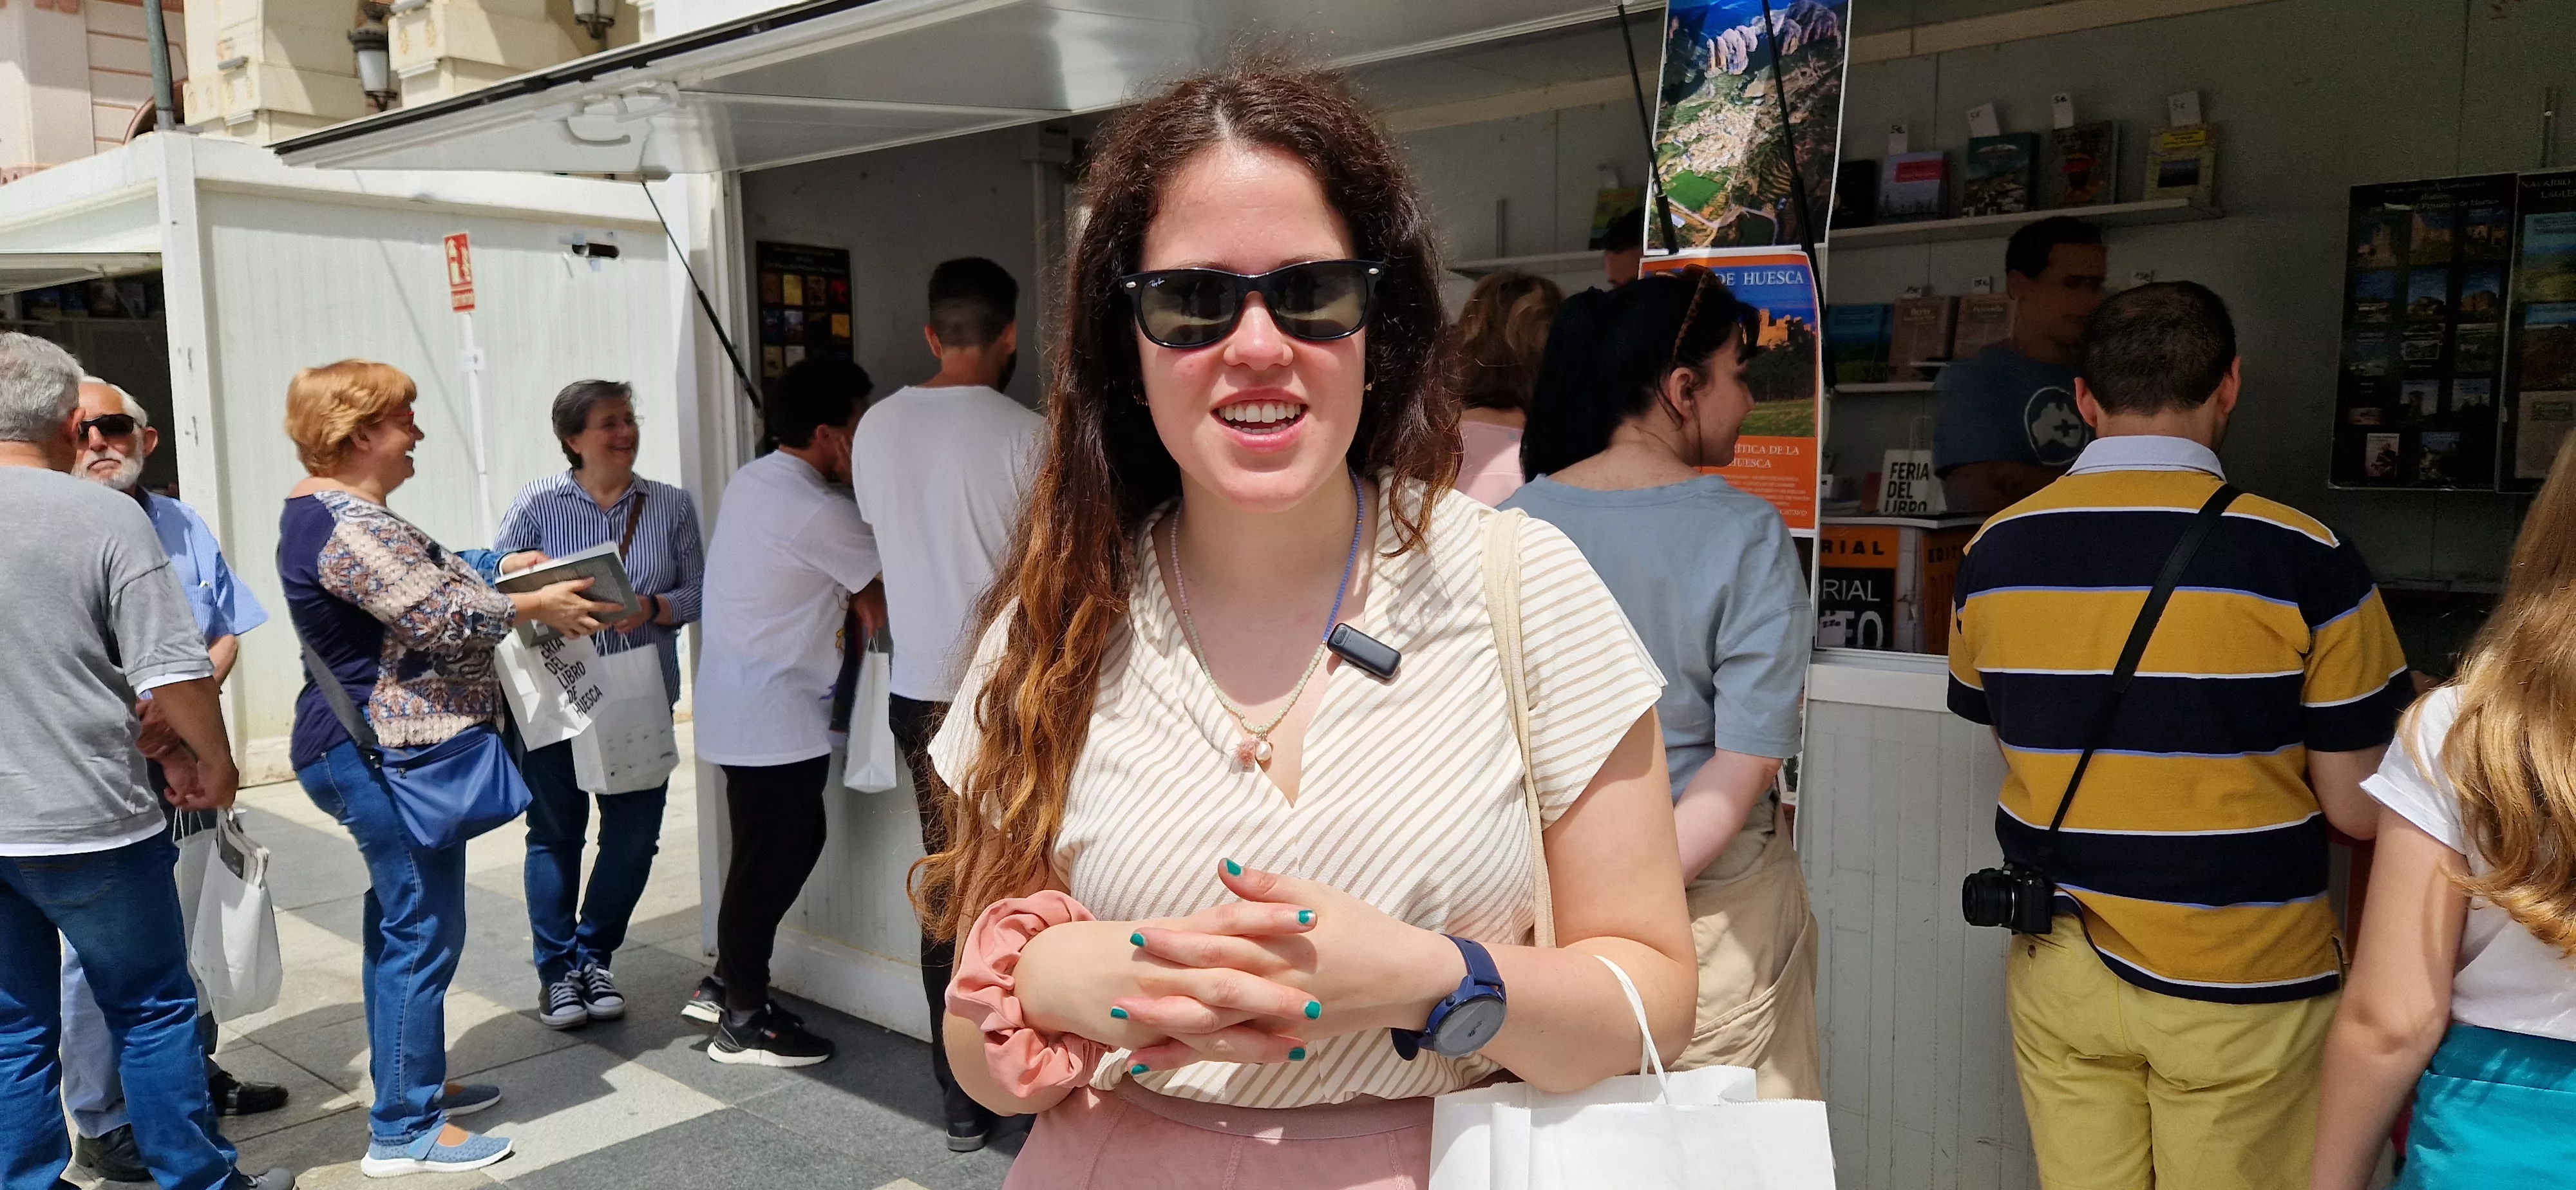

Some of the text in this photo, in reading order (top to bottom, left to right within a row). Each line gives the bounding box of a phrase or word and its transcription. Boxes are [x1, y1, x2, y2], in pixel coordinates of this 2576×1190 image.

[1742, 270, 1804, 285] HUESCA
[1769, 445, 1783, 455] DE
[1786, 446, 1800, 455] LA
[1889, 462, 1929, 481] FERIA
[1887, 480, 1913, 500] DEL
[544, 656, 568, 676] DEL
[557, 661, 586, 690] LIBRO
[566, 685, 578, 704] DE
[572, 684, 604, 719] HUESCA
